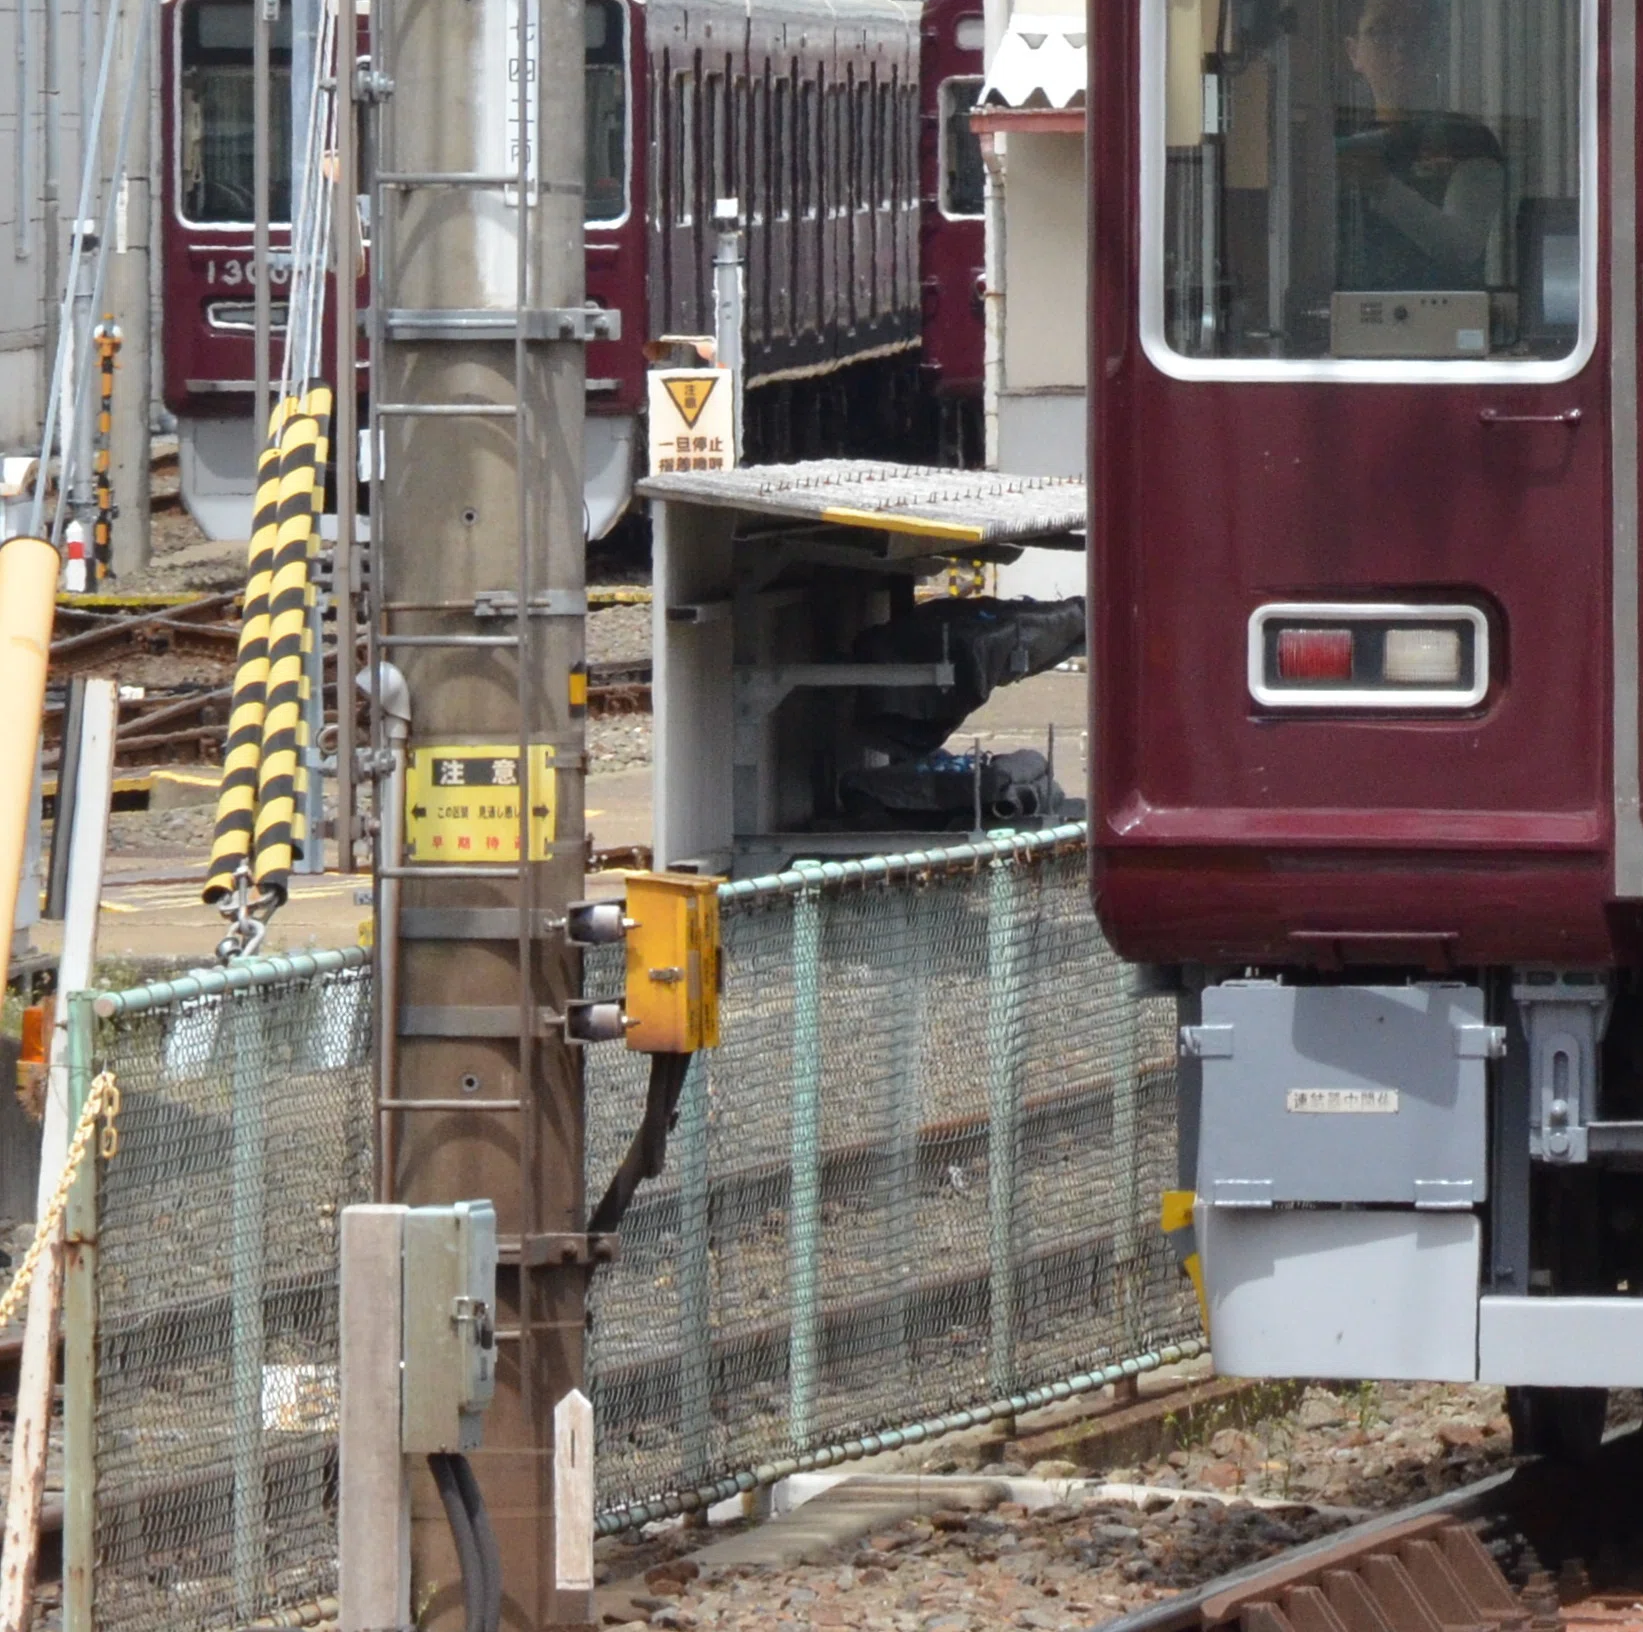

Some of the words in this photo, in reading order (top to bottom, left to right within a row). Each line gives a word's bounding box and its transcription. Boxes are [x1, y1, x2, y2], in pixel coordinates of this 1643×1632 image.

[657, 436, 724, 453] 一旦停止
[440, 758, 518, 786] 注意
